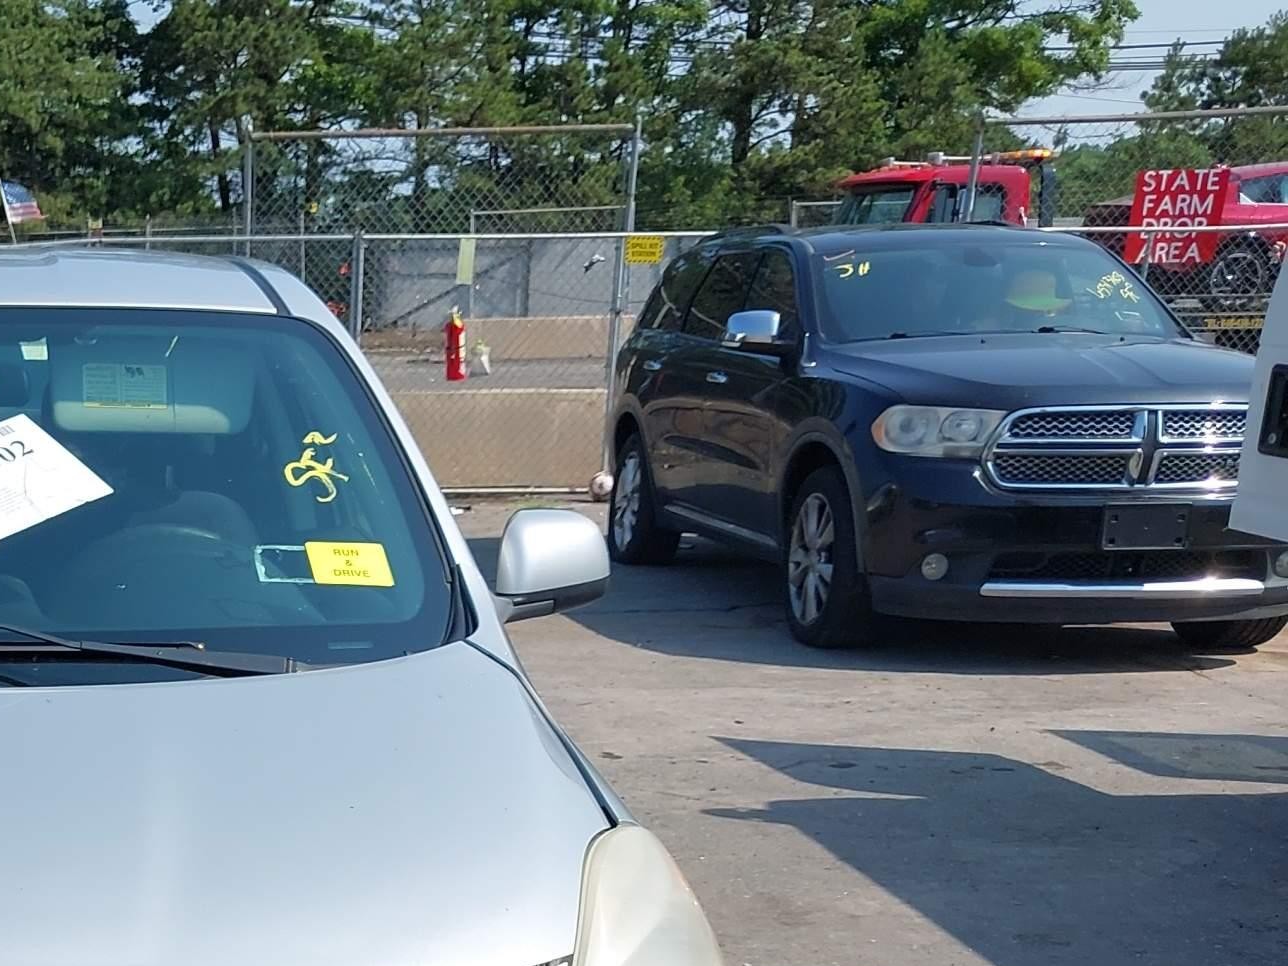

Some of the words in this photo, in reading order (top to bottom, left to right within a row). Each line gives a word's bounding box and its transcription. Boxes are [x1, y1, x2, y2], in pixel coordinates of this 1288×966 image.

[1141, 169, 1223, 192] STATE
[1142, 193, 1215, 216] FARM
[1139, 217, 1208, 239] DROP
[1134, 242, 1201, 264] AREA
[332, 548, 360, 557] RUN
[333, 568, 371, 578] DRIVE
